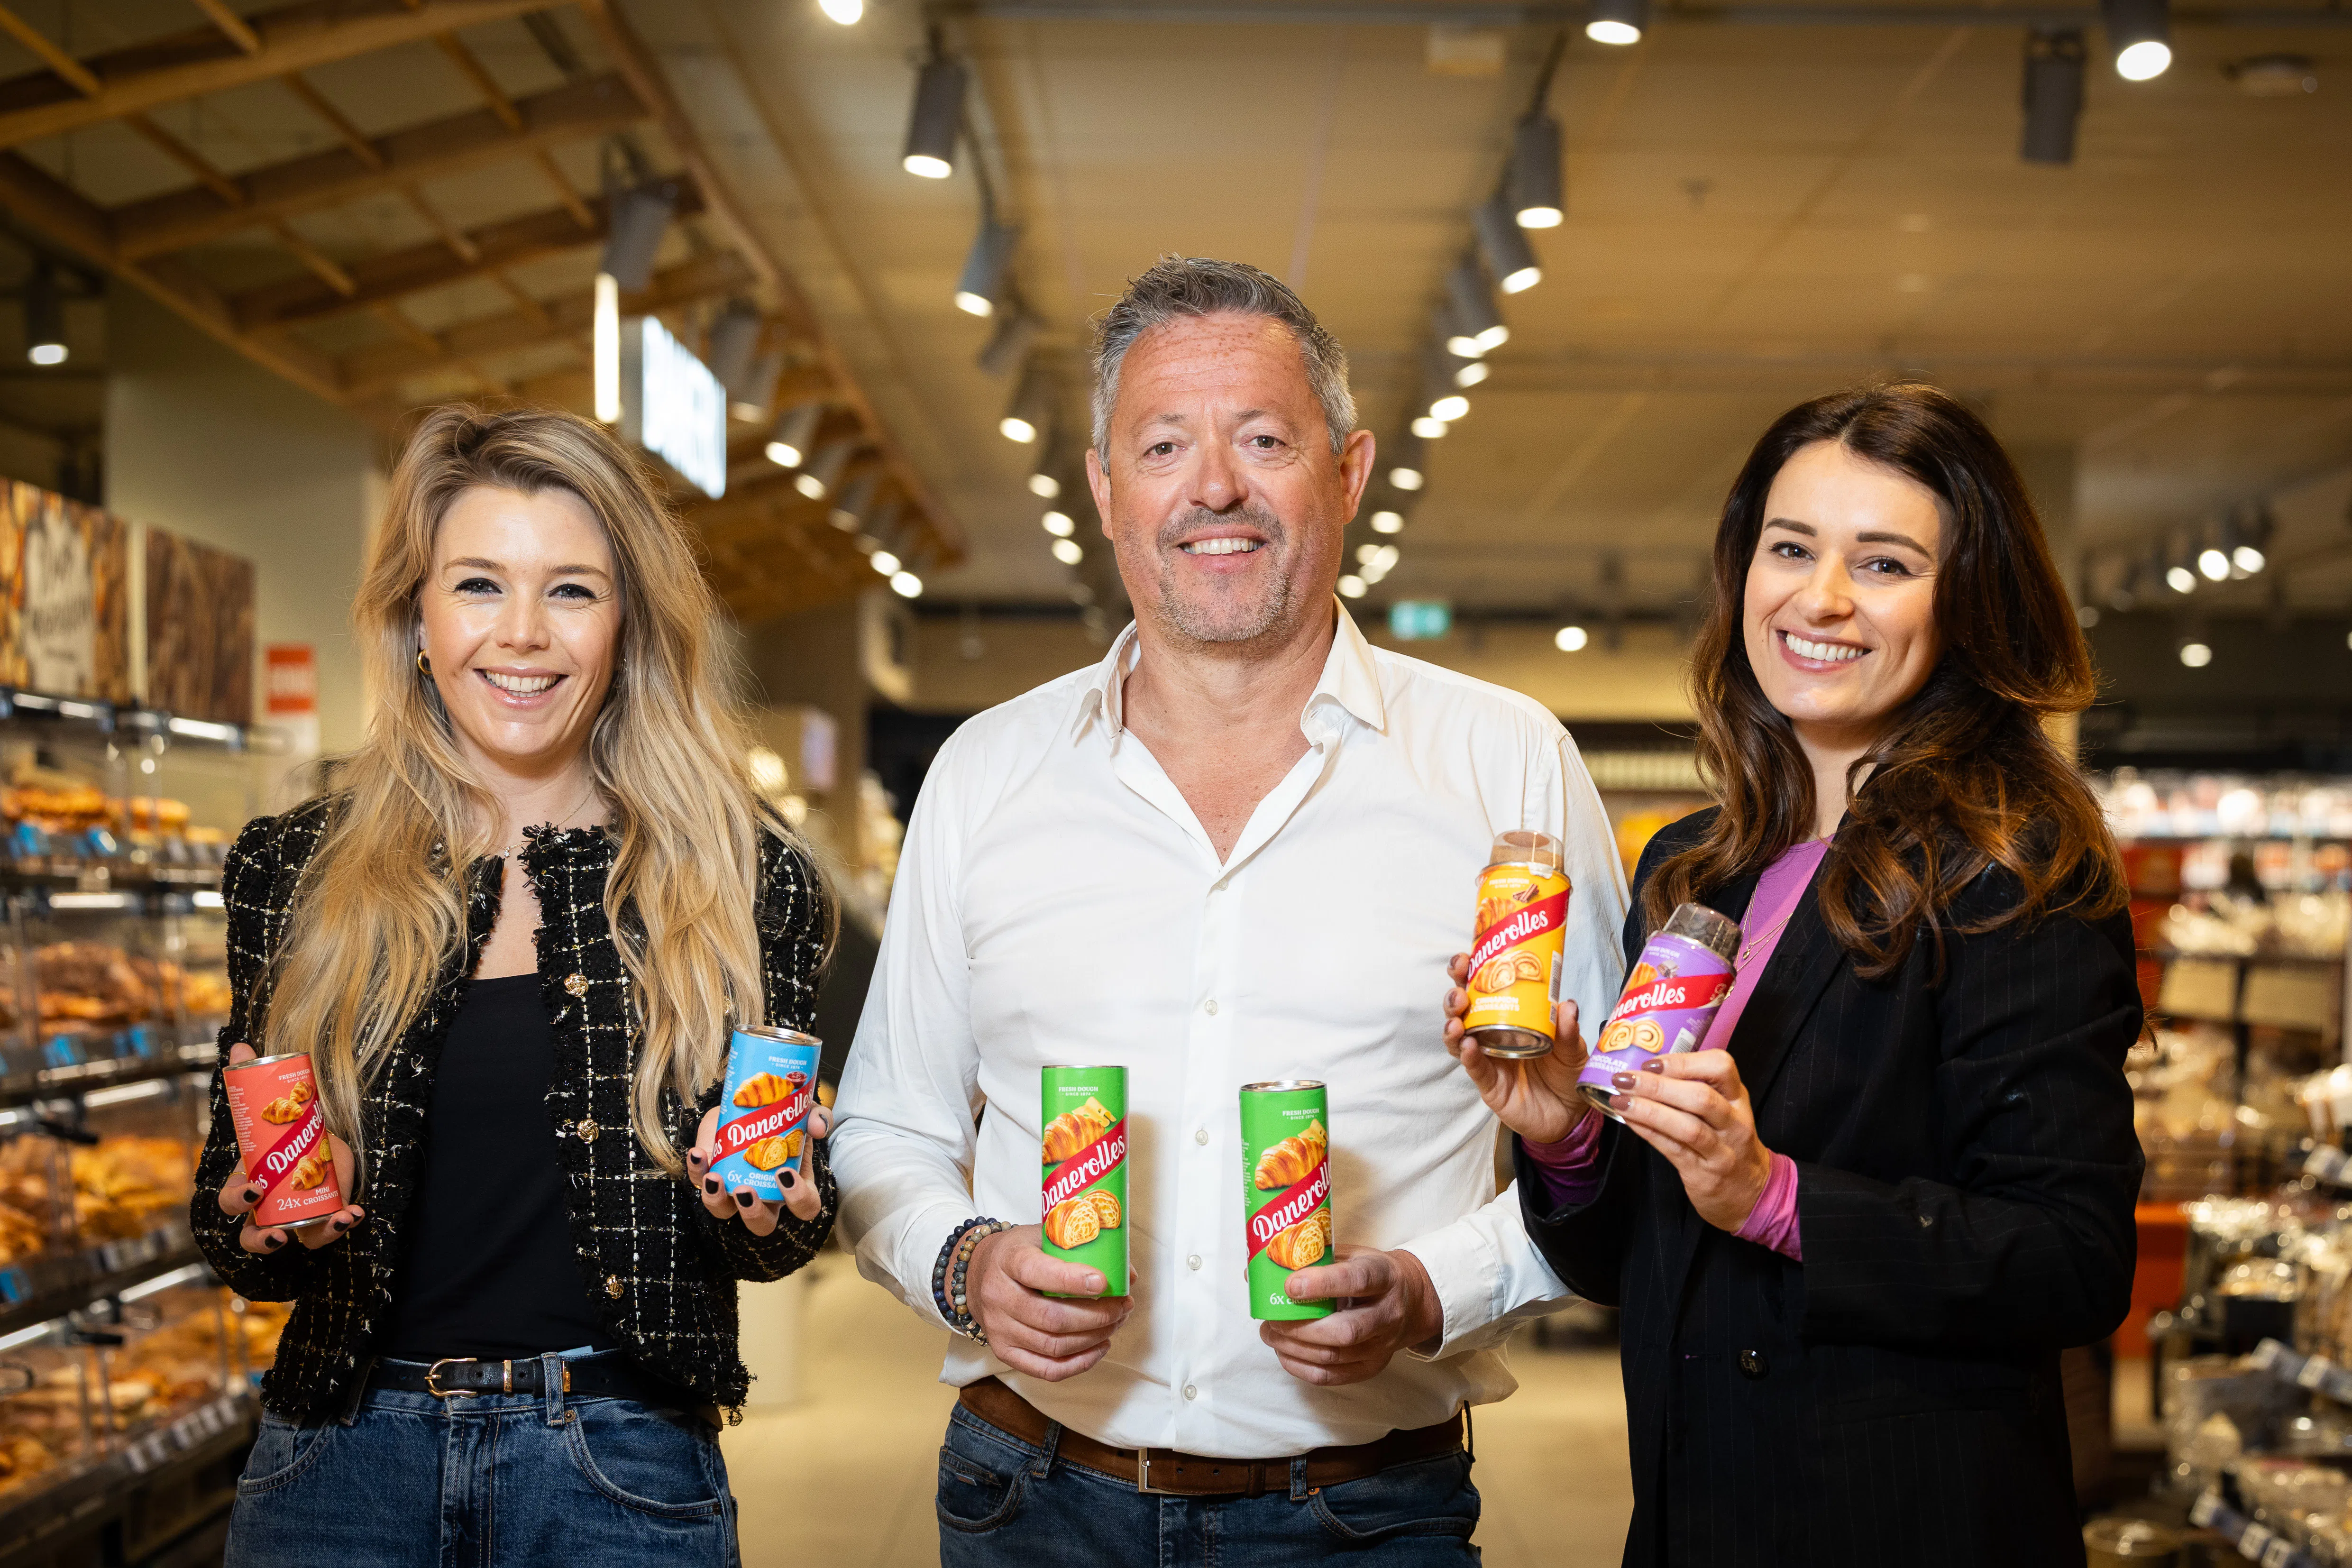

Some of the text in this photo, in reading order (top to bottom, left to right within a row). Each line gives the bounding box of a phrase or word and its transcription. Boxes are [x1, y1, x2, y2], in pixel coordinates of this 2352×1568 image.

[279, 1073, 296, 1081] FRESH
[315, 1186, 330, 1195] MINI
[303, 1190, 339, 1205] CROISSANTS
